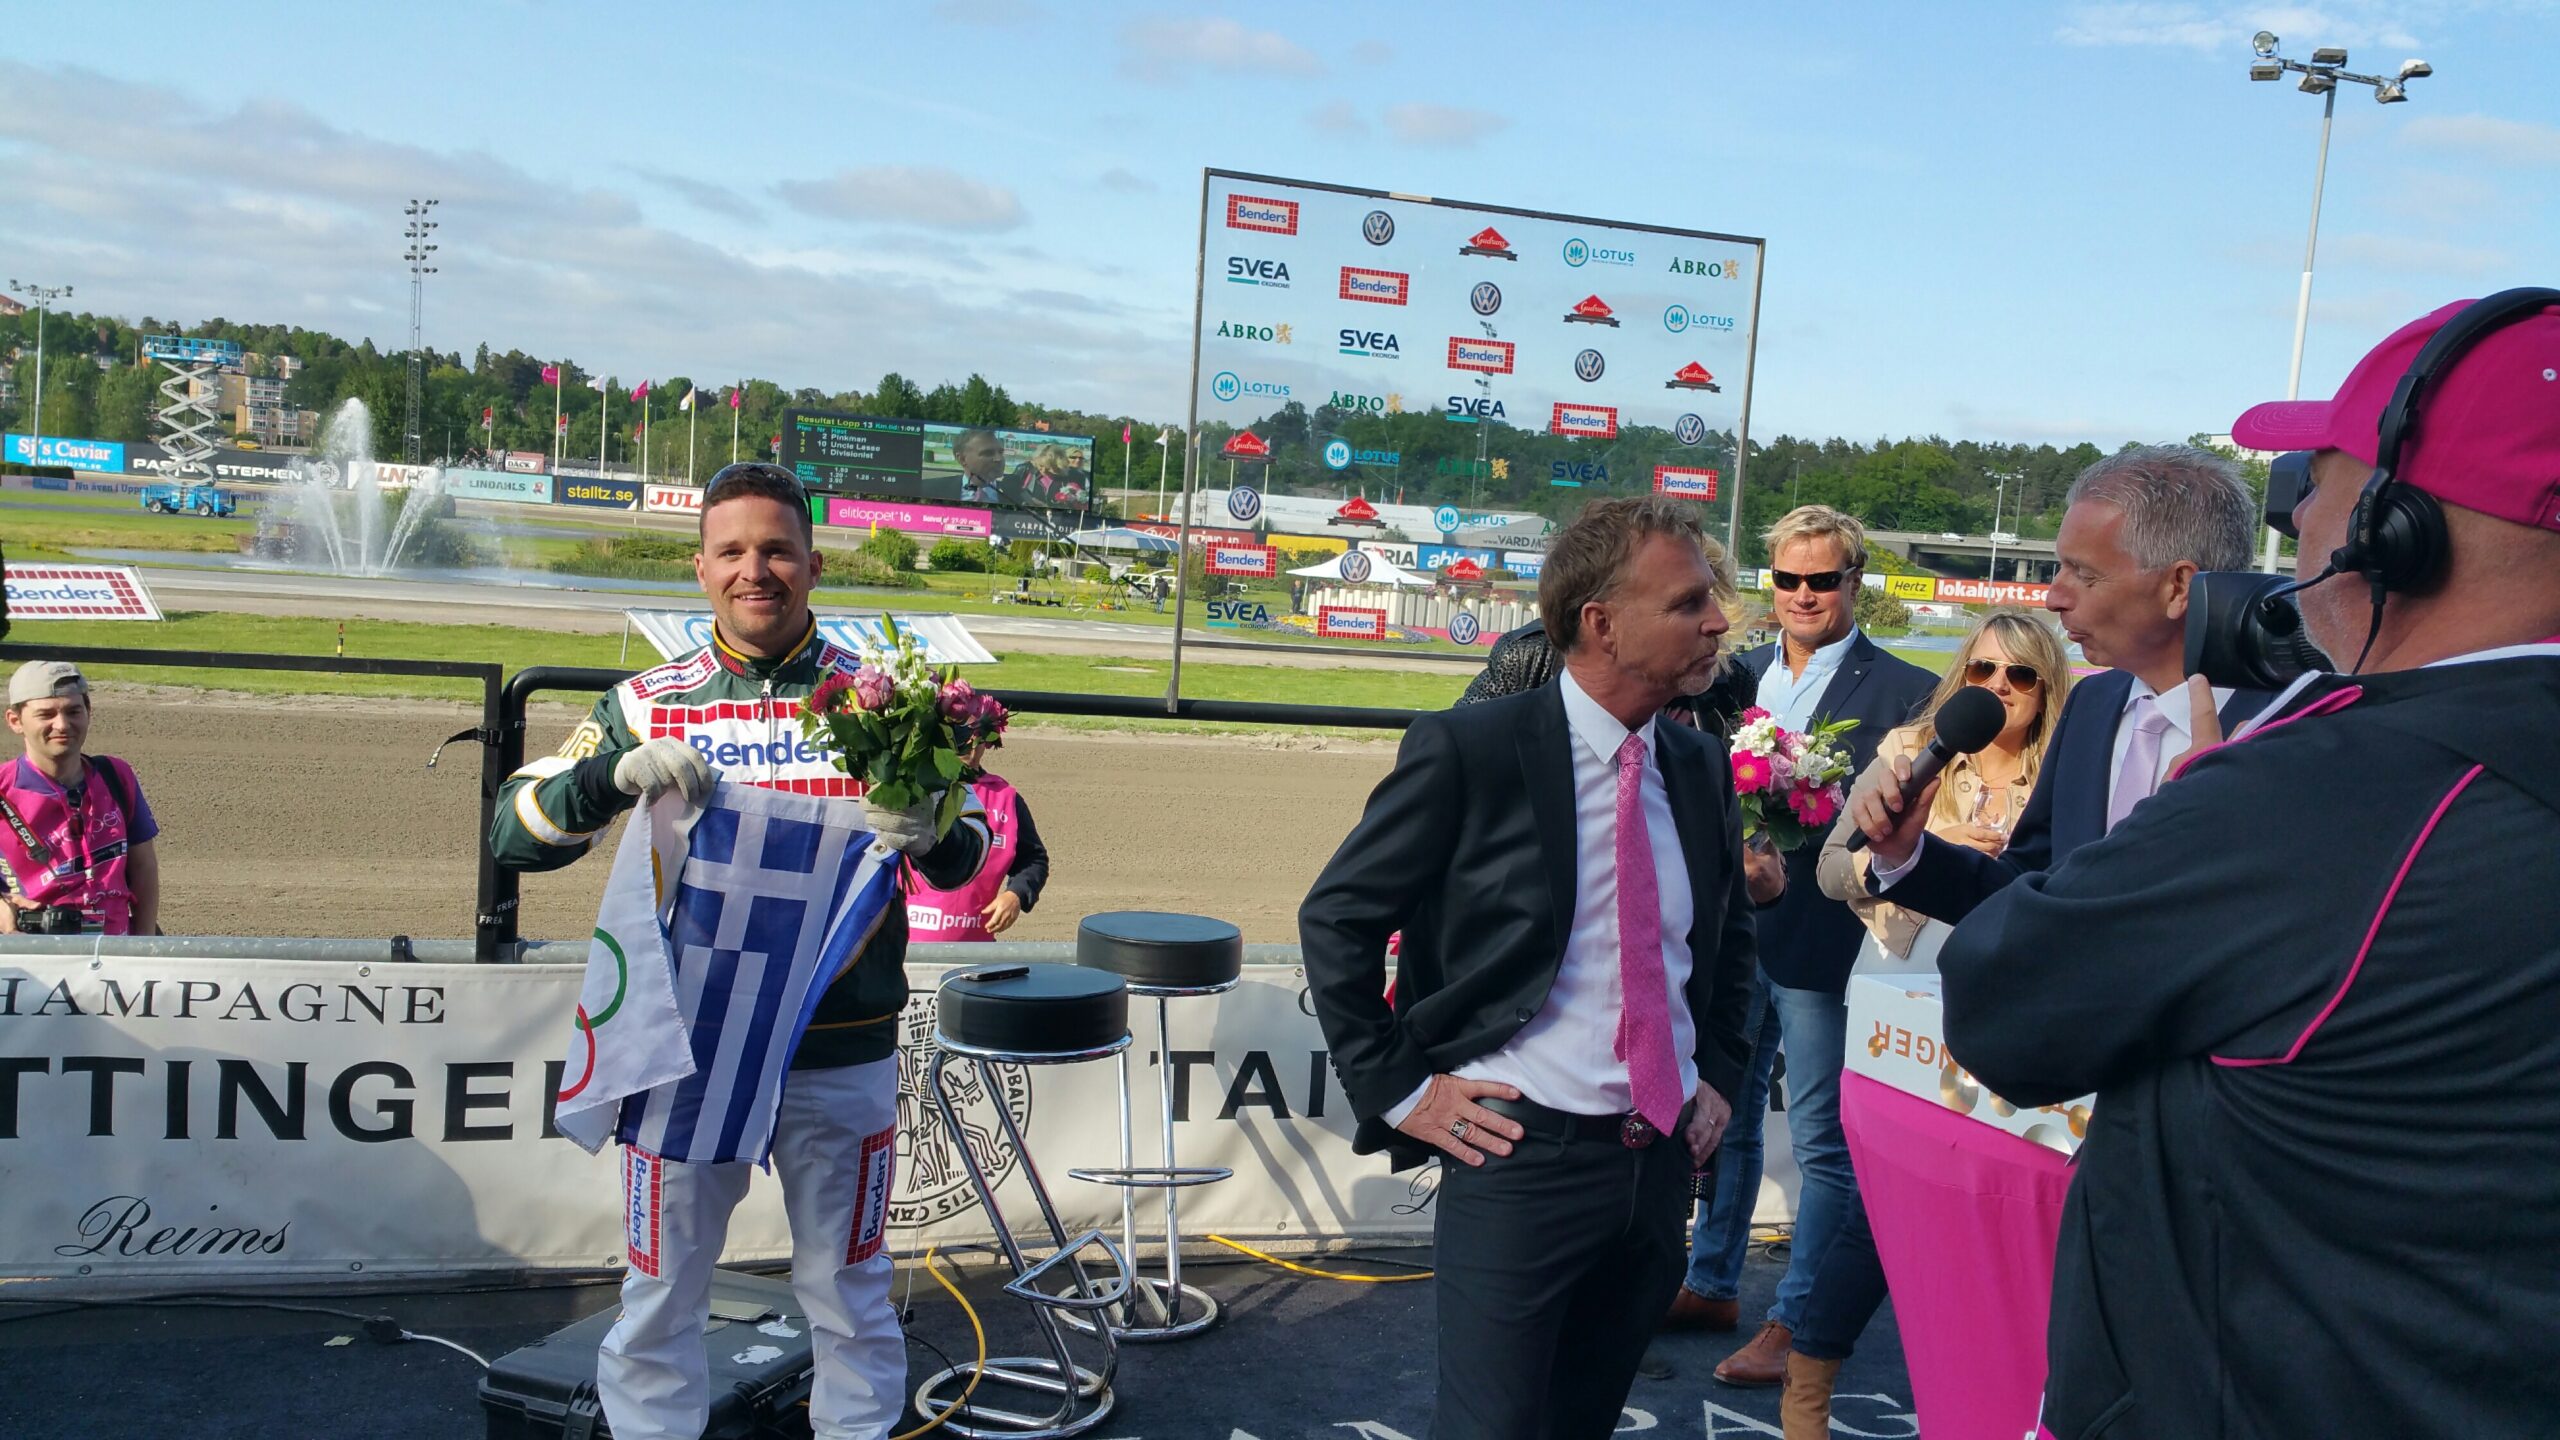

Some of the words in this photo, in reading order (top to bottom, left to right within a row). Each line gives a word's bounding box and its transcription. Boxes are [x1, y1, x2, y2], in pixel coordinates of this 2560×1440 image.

[1238, 205, 1288, 223] Benders
[1592, 248, 1635, 262] LOTUS
[1227, 256, 1291, 281] SVEA
[1668, 257, 1722, 278] ÅBRO
[1350, 277, 1398, 295] Benders
[1692, 314, 1734, 327] LOTUS
[1217, 320, 1274, 342] ÅBRO
[1339, 329, 1400, 351] SVEA
[1458, 347, 1504, 363] Benders
[1243, 382, 1291, 396] LOTUS
[1328, 390, 1385, 412] ÅBRO
[1447, 396, 1506, 418] SVEA
[797, 415, 835, 425] Resultat
[837, 419, 860, 429] Lopp
[862, 421, 873, 429] 13
[1562, 413, 1607, 428] Benders
[817, 440, 827, 448] 10
[830, 442, 855, 450] Uncle
[831, 434, 867, 443] Pinkman
[55, 441, 112, 461] Caviar
[1354, 449, 1400, 463] LOTUS
[215, 463, 303, 480] STEPHEN
[1551, 461, 1608, 481] SVEA
[469, 480, 527, 492] LINDAHLS
[1663, 475, 1707, 490] Benders
[567, 485, 634, 502] stalltz.se
[839, 507, 895, 521] elitloppet
[1462, 514, 1508, 526] LOTUS
[1216, 551, 1265, 566] Benders
[5, 584, 114, 600] Benders
[1894, 580, 1928, 593] Hertz
[1206, 602, 1269, 622] SVEA
[1328, 615, 1375, 630] Benders
[645, 667, 703, 688] Benders
[942, 911, 982, 931] print
[633, 1156, 647, 1249] Benders
[864, 1150, 888, 1243] Benders
[54, 1195, 291, 1257] Reims
